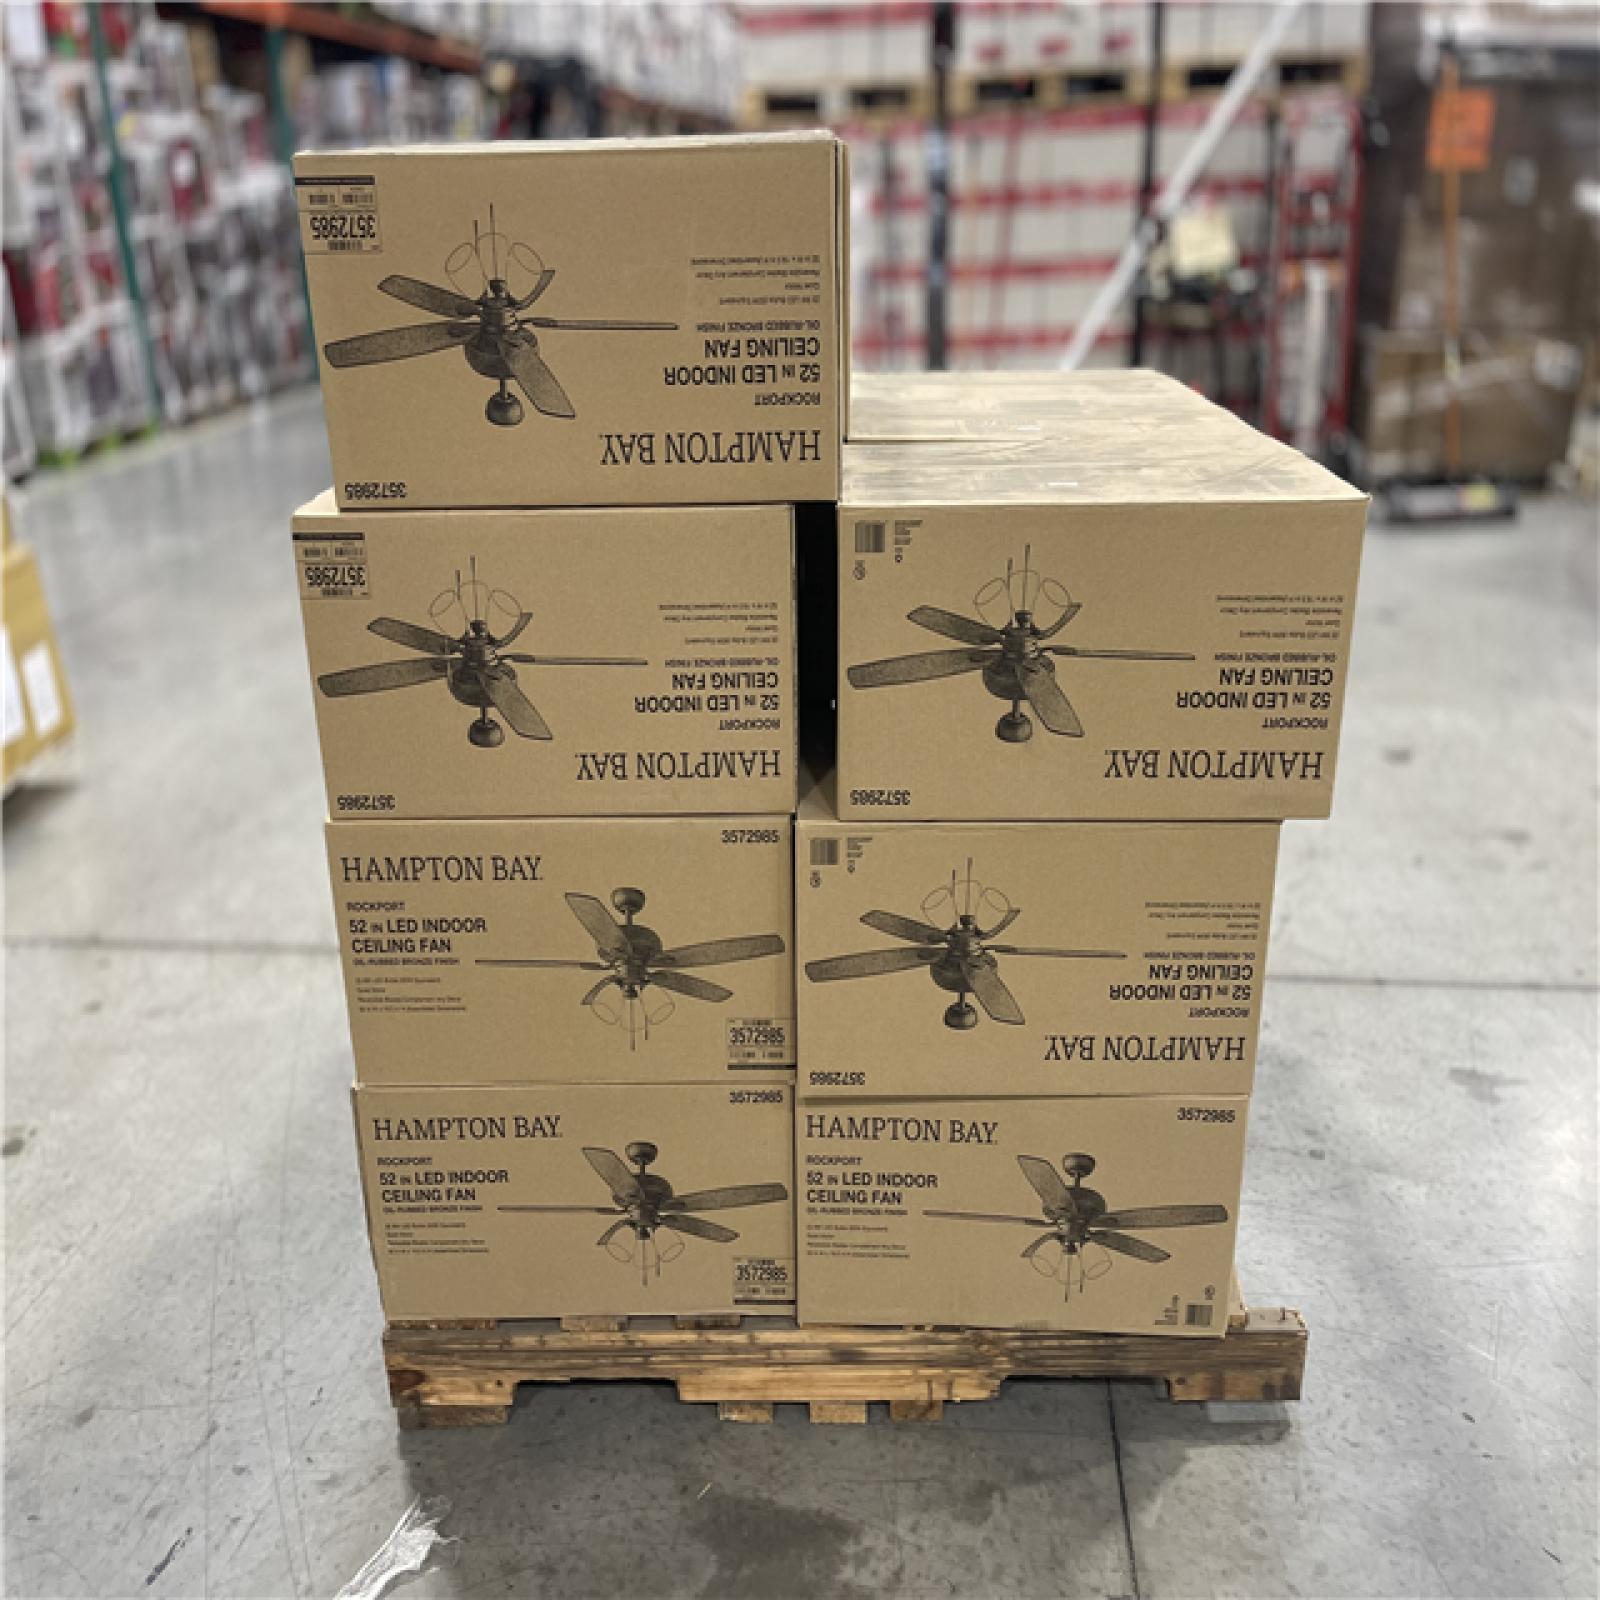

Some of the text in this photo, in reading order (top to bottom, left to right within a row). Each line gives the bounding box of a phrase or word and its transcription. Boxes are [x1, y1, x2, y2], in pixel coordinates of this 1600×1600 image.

[310, 215, 376, 239] 3572985
[705, 337, 820, 357] CEILING FAN
[664, 366, 736, 385] INDOOR
[742, 365, 776, 384] LED
[800, 364, 820, 383] 52
[755, 393, 820, 406] ROCKPORT
[664, 430, 821, 463] HAMPTON
[345, 482, 406, 499] 3572985
[305, 567, 366, 587] 3572985
[673, 672, 778, 689] CEILING FAN
[1220, 668, 1334, 685] CEILING FAN
[635, 696, 701, 712] INDOOR
[707, 695, 739, 711] LED
[760, 694, 778, 710] 52
[1176, 691, 1248, 708] INDOOR
[1254, 691, 1288, 708] LED
[1310, 692, 1331, 709] 52
[719, 719, 780, 730] ROCKPORT
[1262, 717, 1328, 728] ROCKPORT
[636, 750, 780, 779] HAMPTON
[1168, 751, 1324, 779] HAMPTON
[337, 795, 395, 810] 3572985
[851, 790, 911, 805] 3572985
[341, 856, 483, 882] HAMPTON
[346, 902, 405, 912] ROCKPORT
[349, 920, 367, 933] 52
[387, 918, 417, 933] LED
[422, 918, 486, 933] INDOOR
[352, 939, 451, 953] CEILING FAN
[1149, 964, 1254, 979] CEILING FAN
[1110, 985, 1175, 1000] INDOOR
[1180, 985, 1212, 1000] LED
[1232, 985, 1251, 1000] 52
[1188, 1007, 1250, 1017] ROCKPORT
[729, 1027, 785, 1046] 3572985
[1103, 1036, 1246, 1061] HAMPTON
[373, 1118, 505, 1140] HAMPTON
[806, 1115, 941, 1142] HAMPTON
[415, 1171, 444, 1184] LED
[448, 1170, 509, 1183] INDOOR
[807, 1172, 823, 1186] 52
[842, 1172, 872, 1186] LED
[877, 1173, 938, 1188] INDOOR
[382, 1188, 475, 1203] CEILING FAN
[807, 1190, 902, 1206] CEILING FAN
